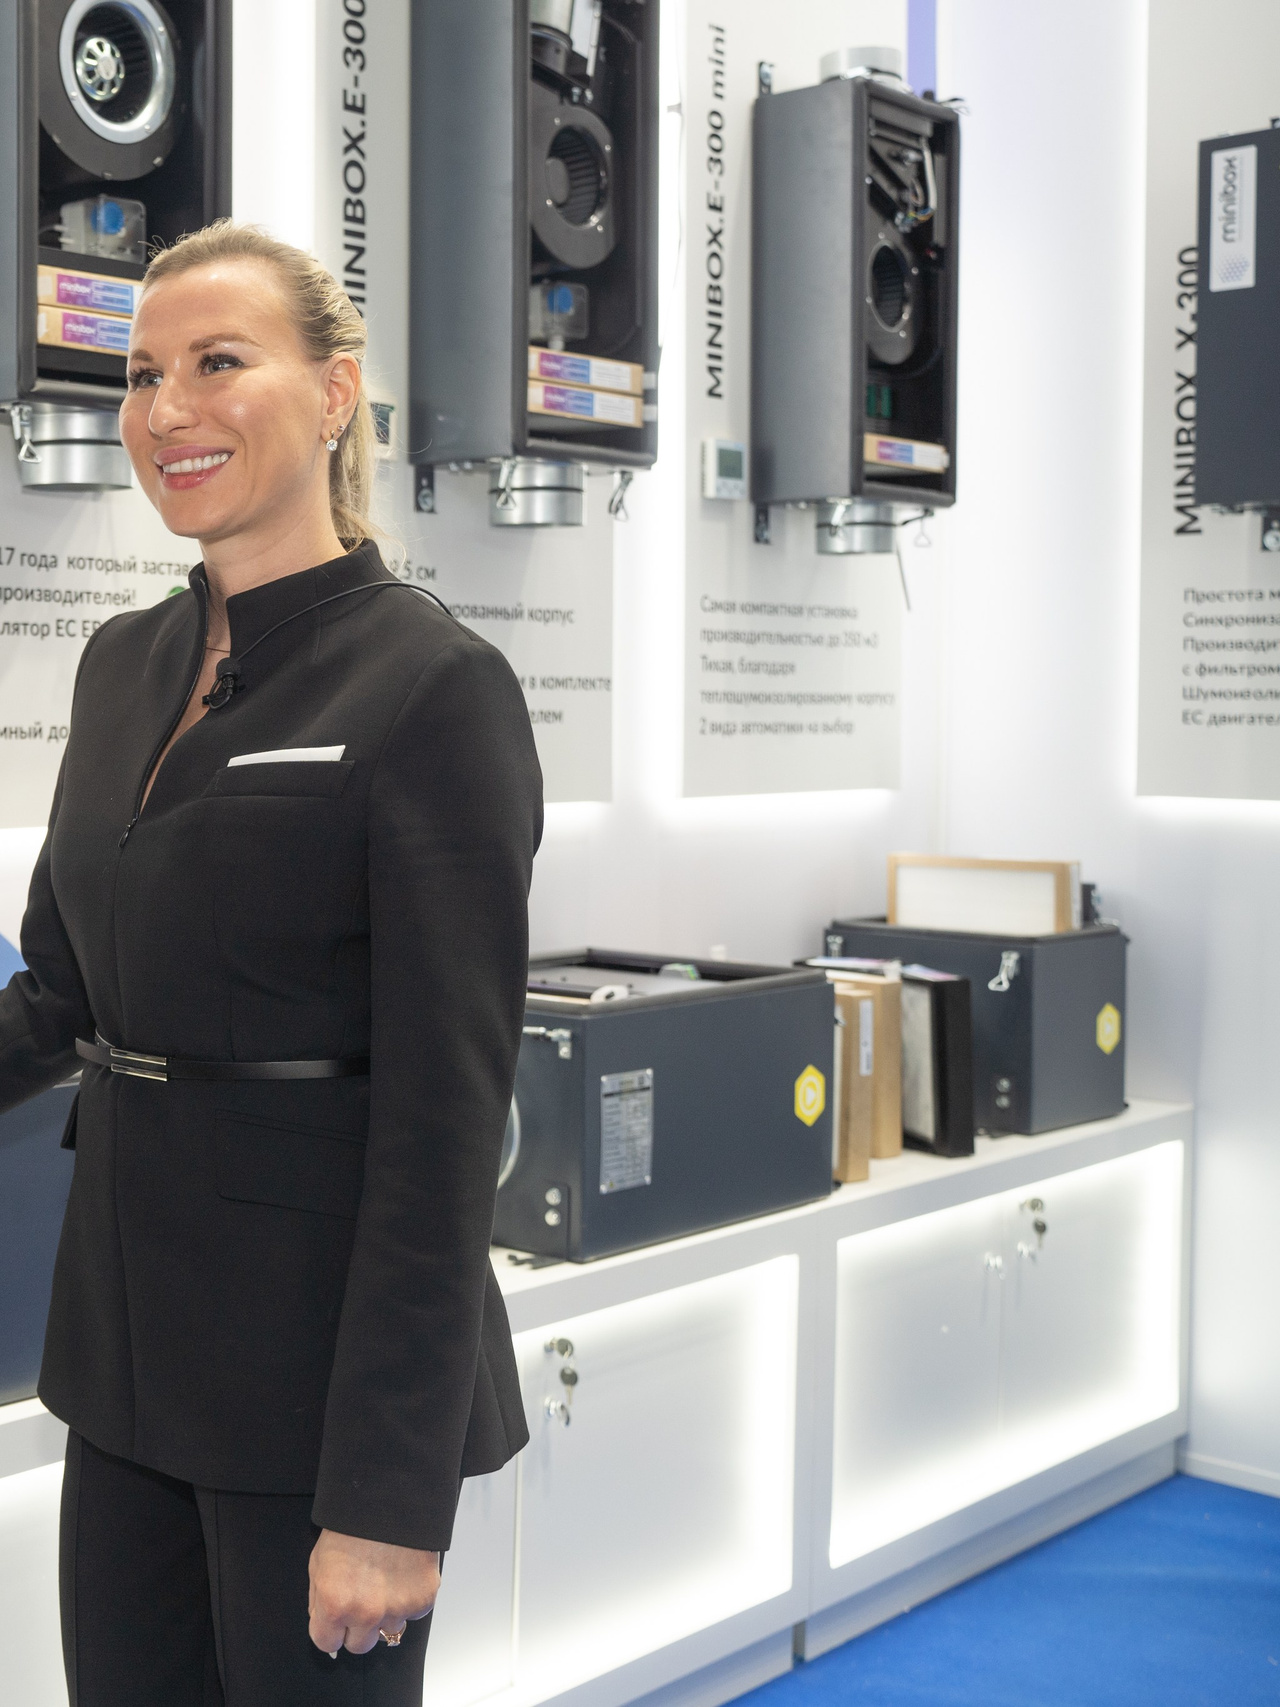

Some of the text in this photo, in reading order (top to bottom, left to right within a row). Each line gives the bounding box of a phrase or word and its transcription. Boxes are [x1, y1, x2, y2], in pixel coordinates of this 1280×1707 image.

[708, 22, 726, 101] mini
[1219, 156, 1237, 243] minibox
[19, 551, 58, 571] года
[67, 556, 137, 574] который
[141, 560, 191, 576] застав
[416, 566, 437, 580] см
[1183, 587, 1264, 606] Простота
[528, 608, 574, 626] корпус
[700, 595, 859, 620] Самая компактная установка
[699, 628, 824, 646] производительностью
[738, 656, 796, 676] благодаря
[539, 676, 612, 691] комплекте
[709, 720, 737, 736] вида
[741, 720, 804, 735] автоматики
[822, 717, 854, 735] выбор
